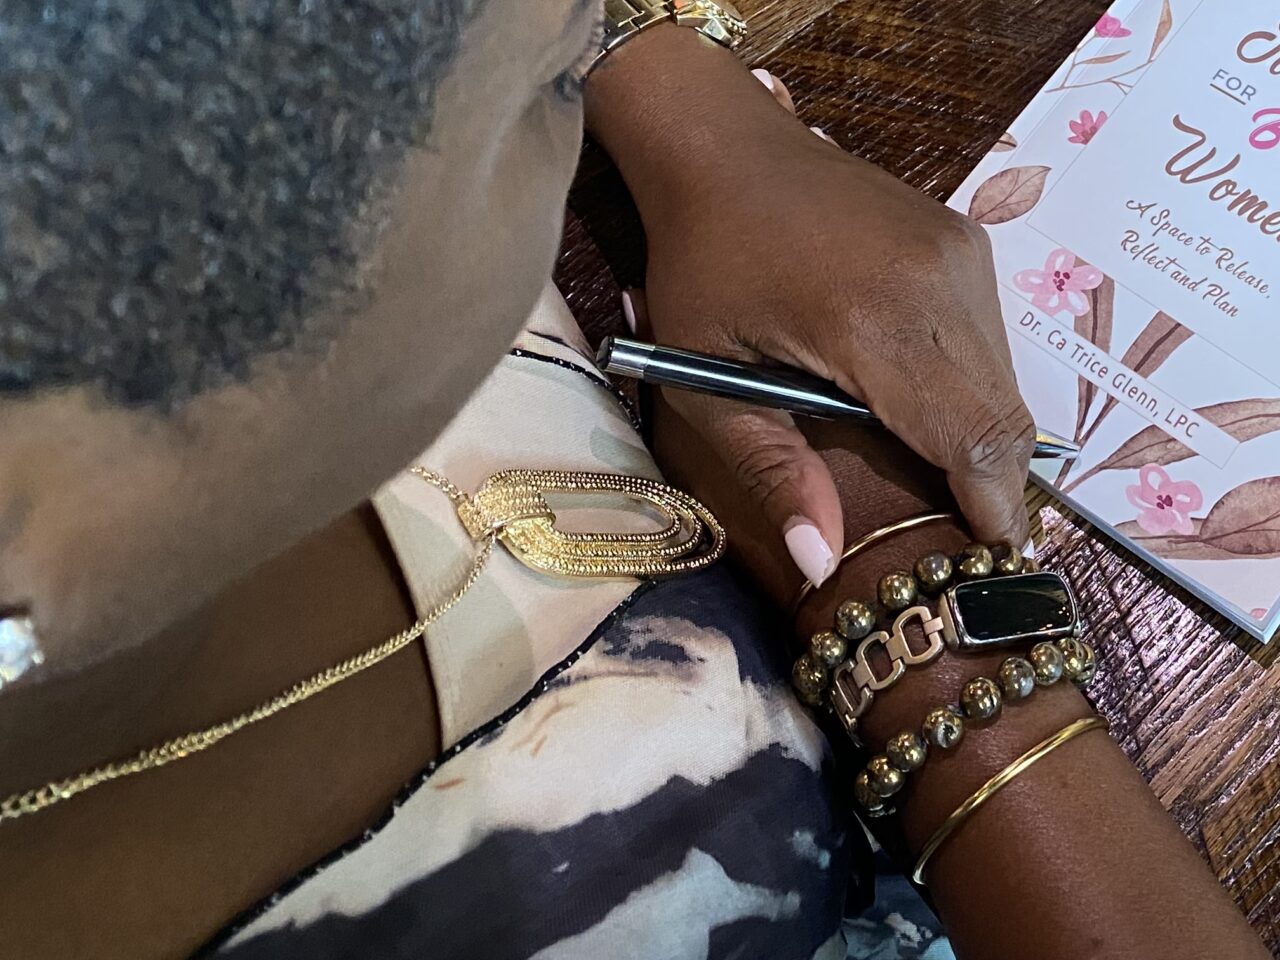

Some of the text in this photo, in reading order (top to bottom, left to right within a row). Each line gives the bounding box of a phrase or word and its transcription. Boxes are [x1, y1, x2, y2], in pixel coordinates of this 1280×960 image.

[1212, 68, 1257, 102] FOR
[1125, 199, 1158, 218] A
[1150, 208, 1193, 246] Space
[1195, 236, 1220, 256] to
[1120, 229, 1239, 318] Reflect and Plan
[1020, 311, 1200, 438] Dr. Ca Trice Glenn, LPC
